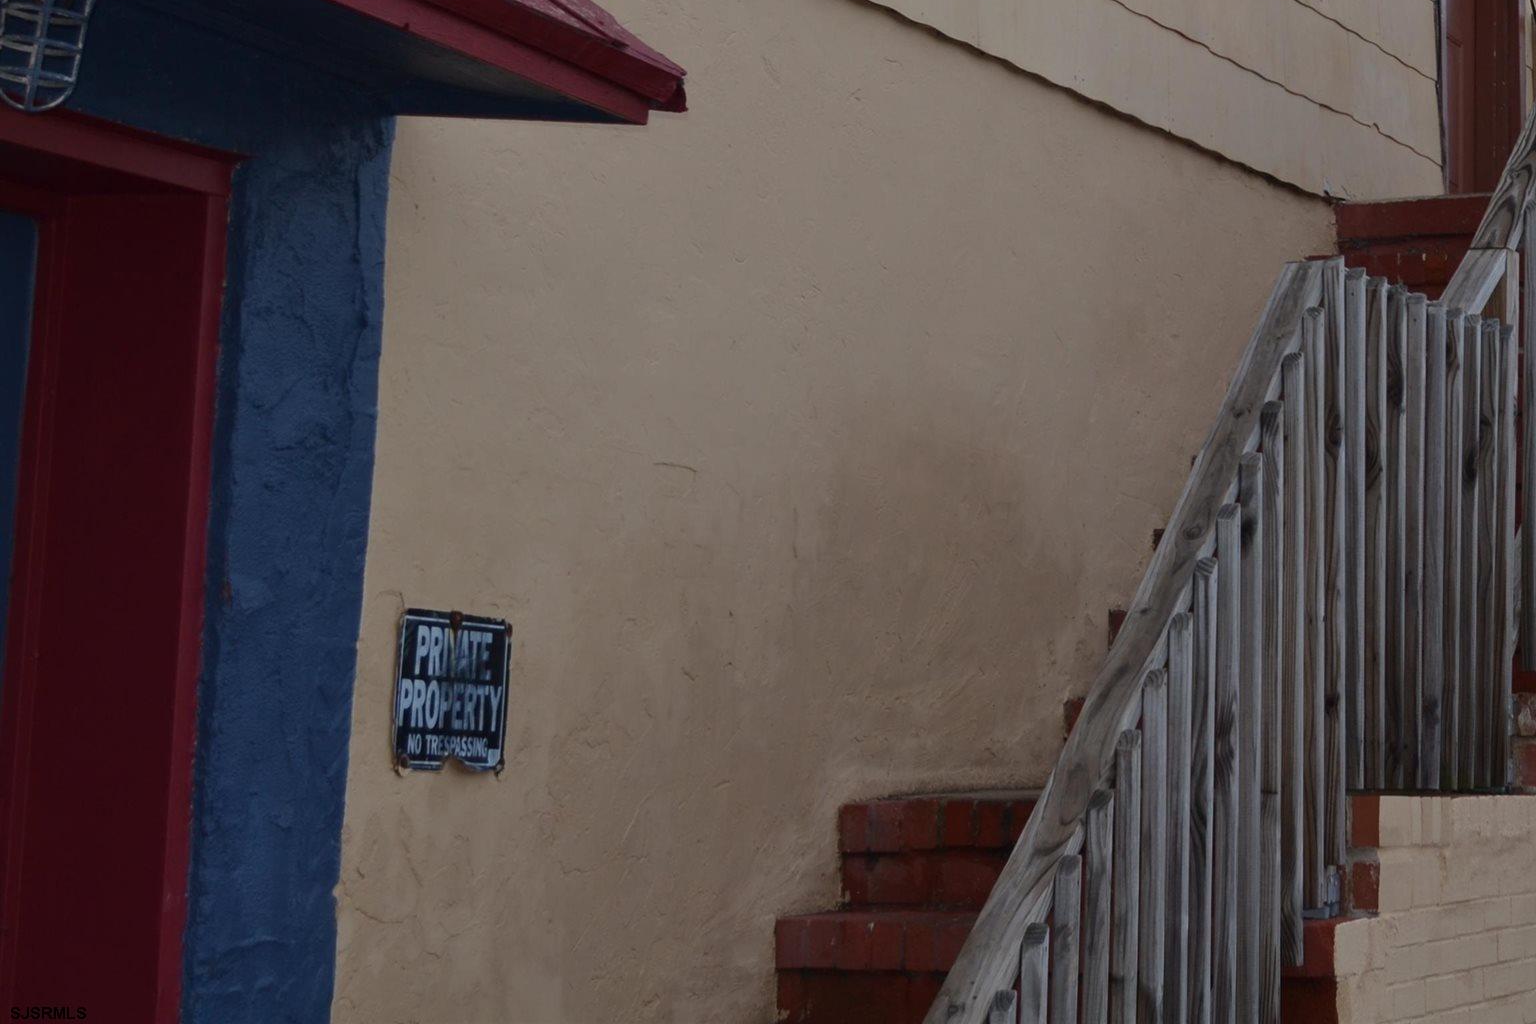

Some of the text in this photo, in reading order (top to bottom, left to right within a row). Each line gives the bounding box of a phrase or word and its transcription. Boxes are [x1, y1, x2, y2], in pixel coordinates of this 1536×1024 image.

[414, 624, 494, 681] PRIVATE
[398, 678, 503, 732] PROPERTY
[407, 733, 422, 755] NO
[425, 734, 489, 758] TRESPASSING
